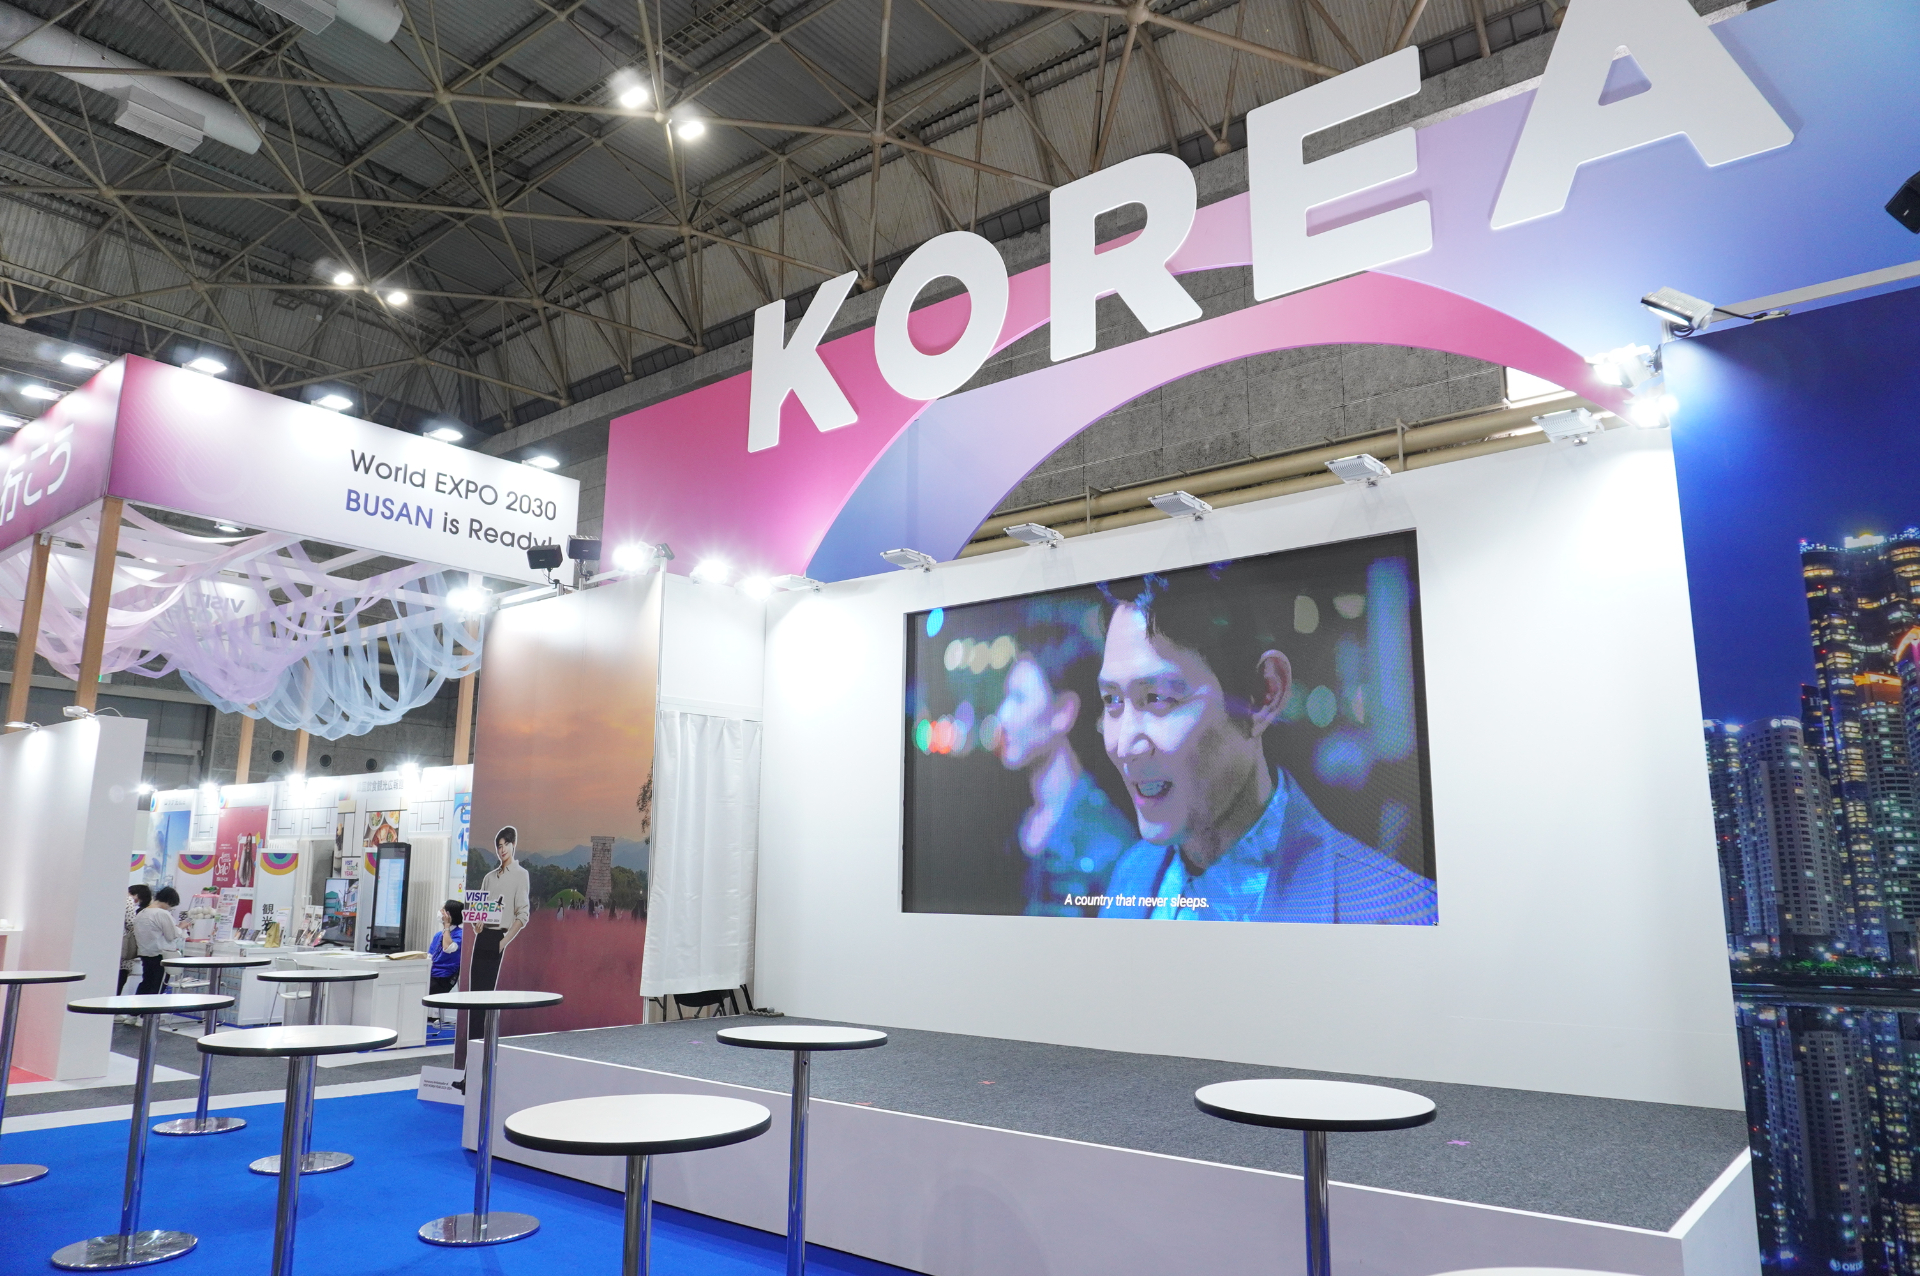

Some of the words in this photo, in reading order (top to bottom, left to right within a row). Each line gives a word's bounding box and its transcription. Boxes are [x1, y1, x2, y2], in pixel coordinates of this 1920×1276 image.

[748, 0, 1794, 454] KOREA
[350, 449, 426, 489] World
[434, 472, 499, 506] EXPO
[505, 491, 557, 521] 2030
[345, 489, 434, 530] BUSAN
[442, 512, 460, 535] is
[466, 892, 489, 902] VISIT
[1064, 893, 1073, 906] A
[1074, 894, 1113, 909] country
[1115, 893, 1136, 907] that
[1138, 896, 1169, 907] never
[1170, 894, 1210, 911] sleeps.
[470, 901, 502, 912] KOREA
[463, 912, 488, 922] YEAR
